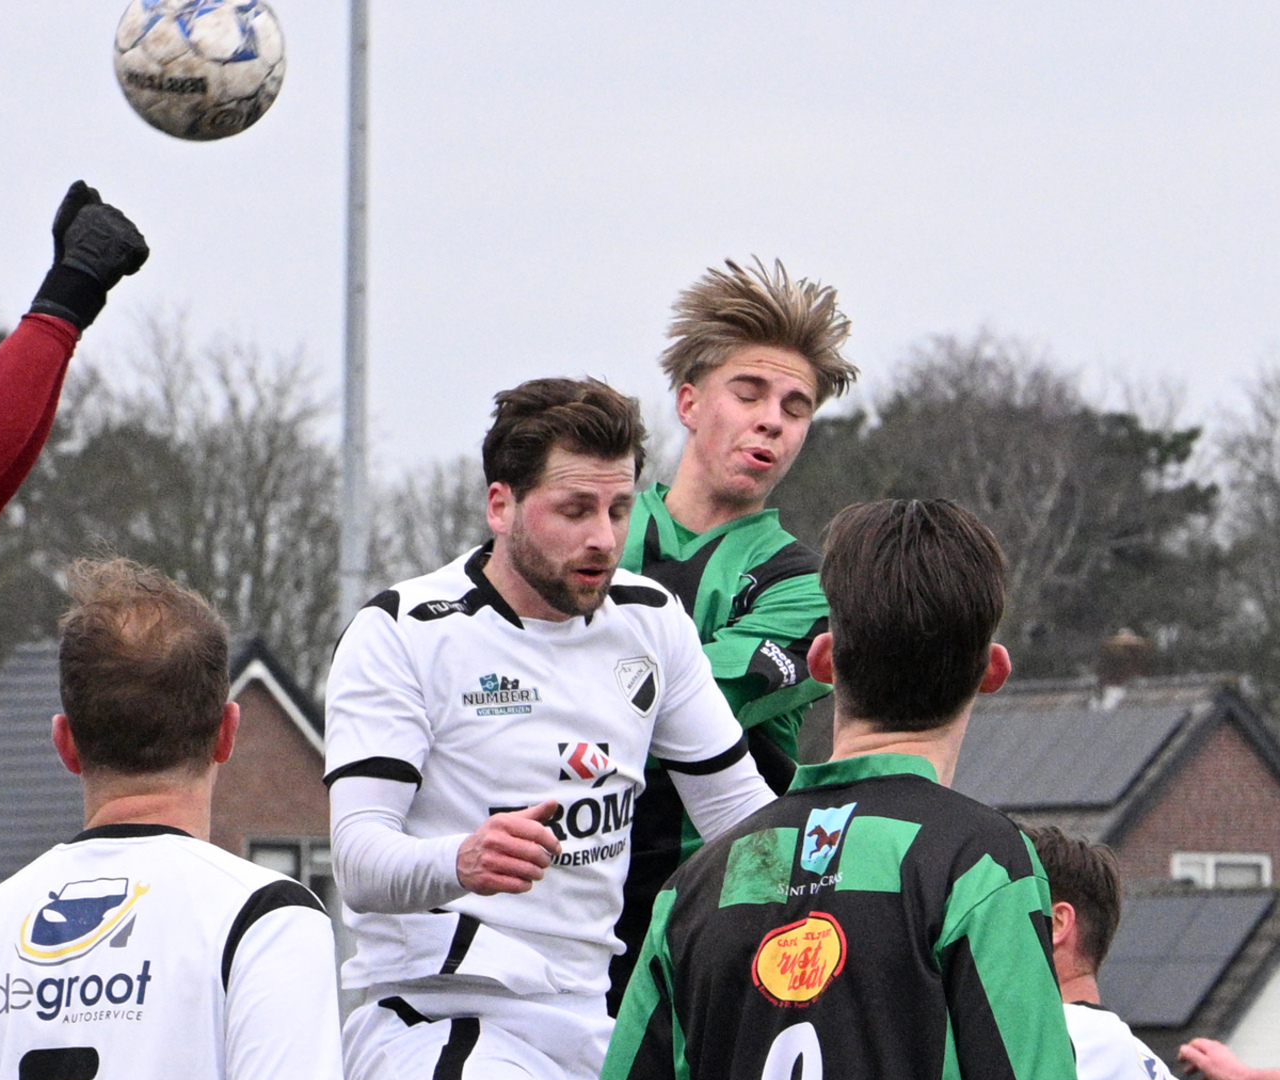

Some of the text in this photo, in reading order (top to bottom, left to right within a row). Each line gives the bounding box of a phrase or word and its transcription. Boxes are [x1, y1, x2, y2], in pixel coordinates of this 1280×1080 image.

[462, 687, 541, 706] NUMBER 1
[62, 1010, 144, 1024] AUTOSERVICE
